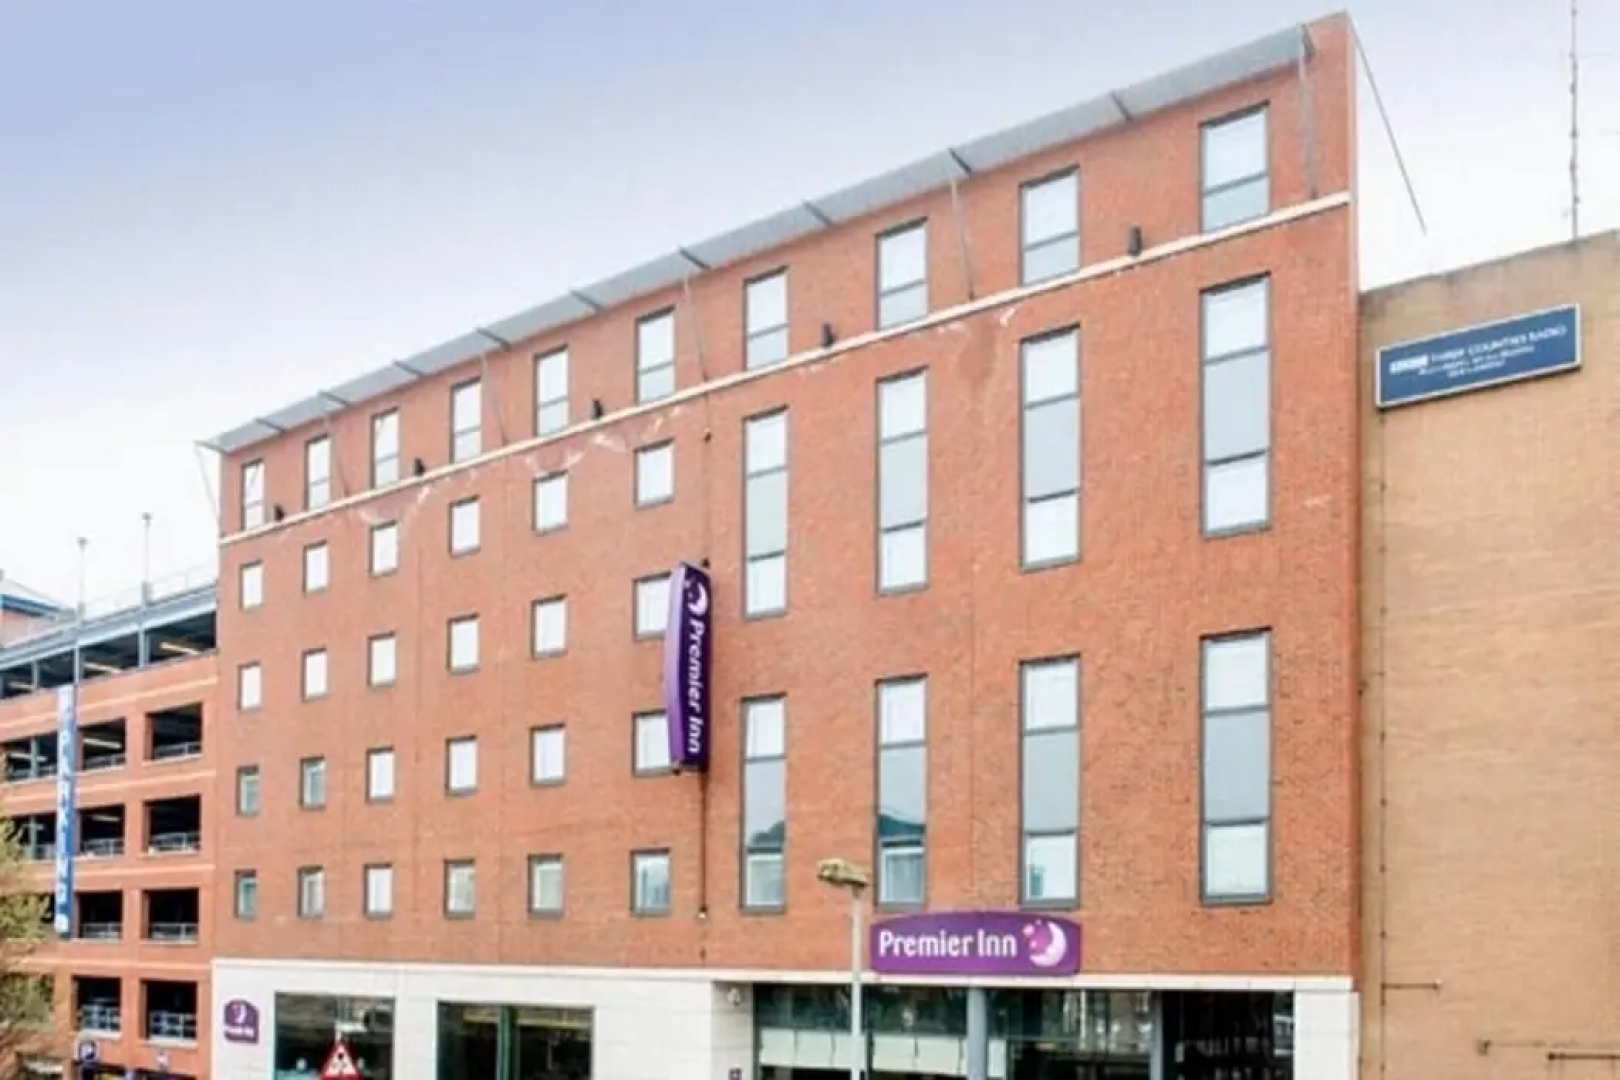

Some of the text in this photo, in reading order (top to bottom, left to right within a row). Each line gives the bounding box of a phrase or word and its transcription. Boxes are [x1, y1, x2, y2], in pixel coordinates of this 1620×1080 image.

[688, 618, 706, 754] Premier Inn
[878, 928, 1018, 958] Premier Inn
